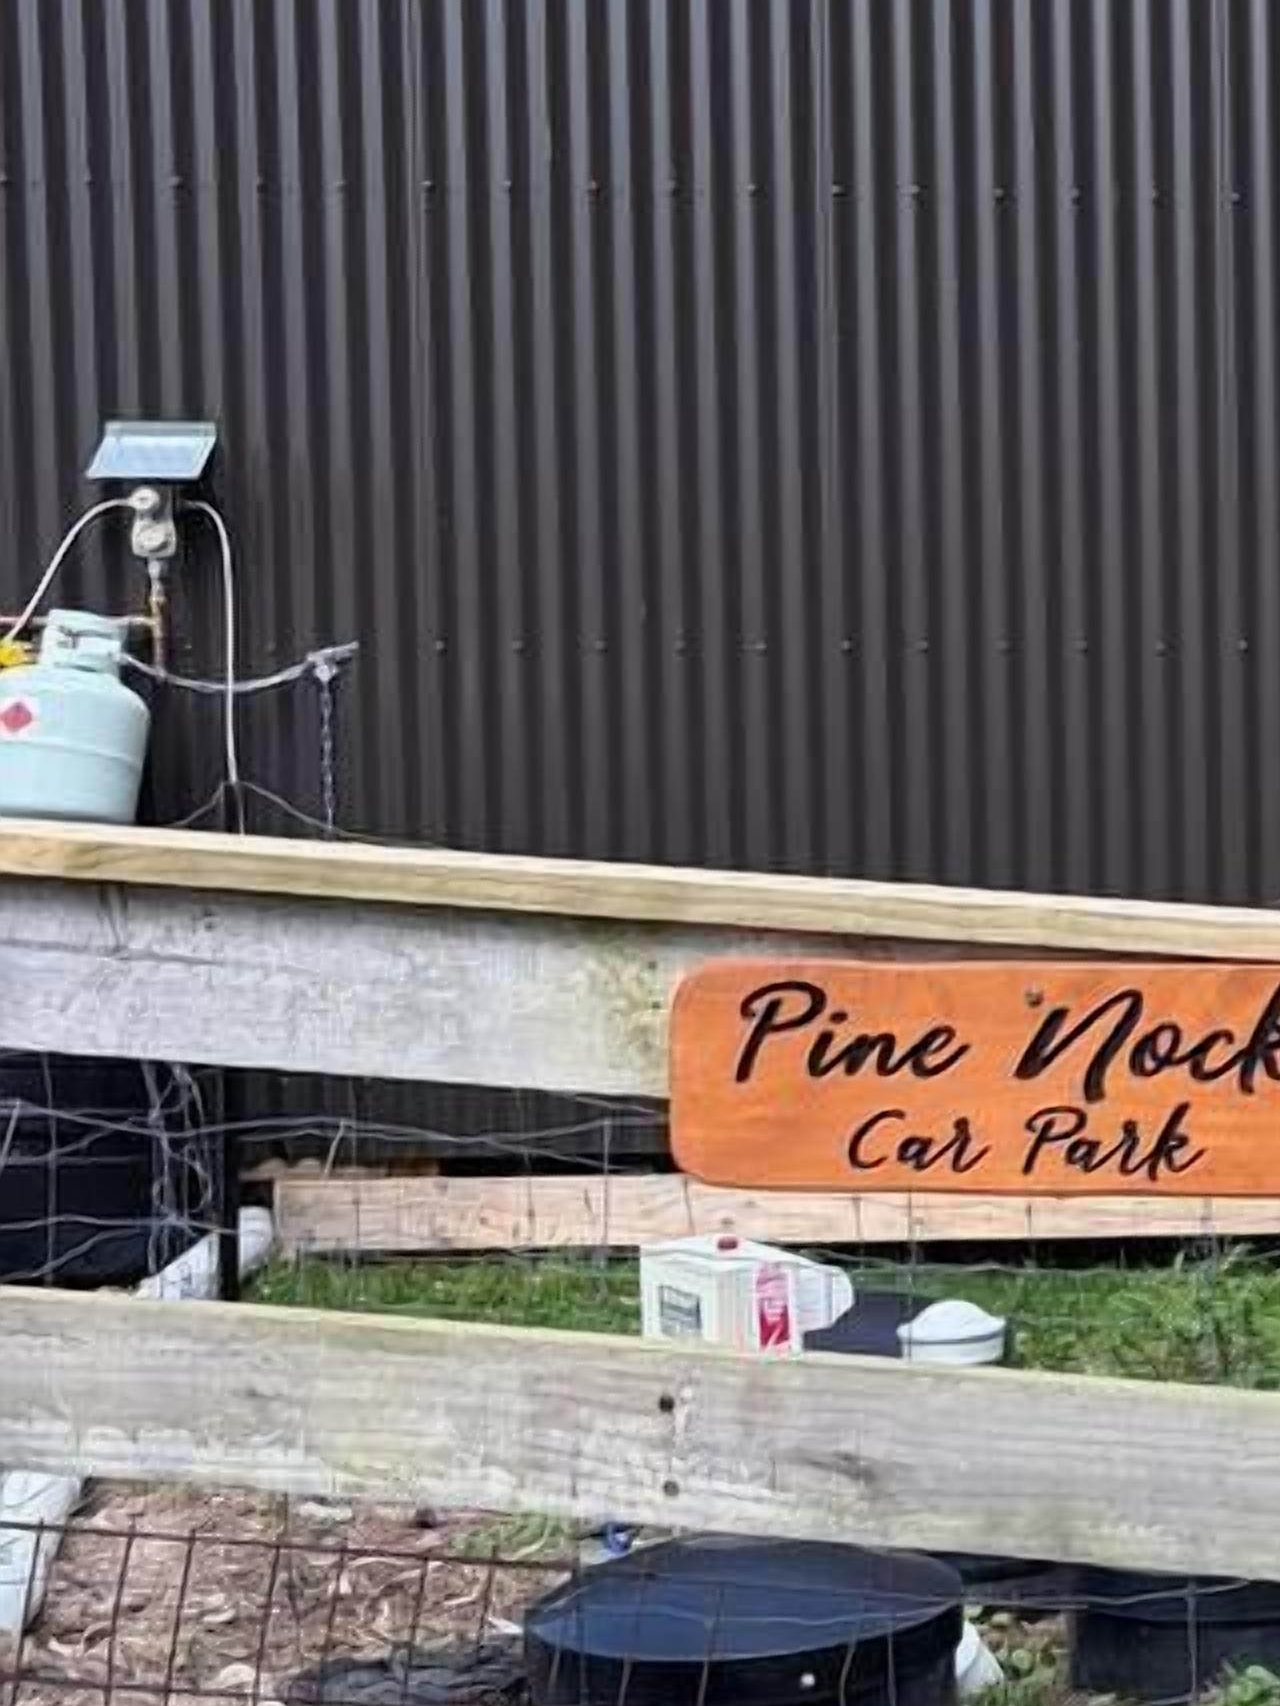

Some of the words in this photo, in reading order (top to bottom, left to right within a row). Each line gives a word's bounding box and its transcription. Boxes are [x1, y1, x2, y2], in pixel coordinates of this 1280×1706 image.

[734, 979, 970, 1084] Pine
[846, 1108, 990, 1173] Car
[1021, 1101, 1207, 1182] Park
